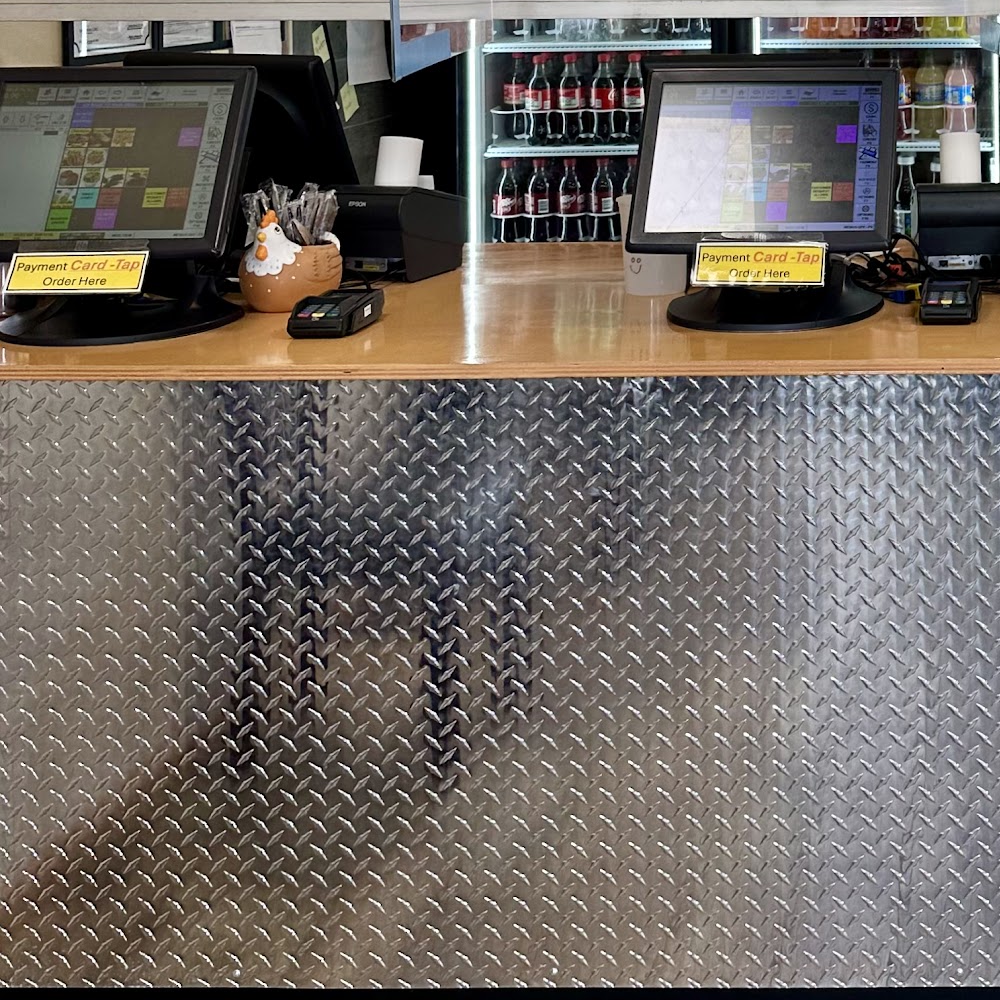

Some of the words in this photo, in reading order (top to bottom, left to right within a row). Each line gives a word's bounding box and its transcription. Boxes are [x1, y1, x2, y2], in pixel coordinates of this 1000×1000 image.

[702, 252, 751, 266] Payment
[753, 250, 787, 264] Card
[790, 251, 820, 266] -Tap
[728, 268, 761, 279] Order
[763, 268, 790, 279] Here
